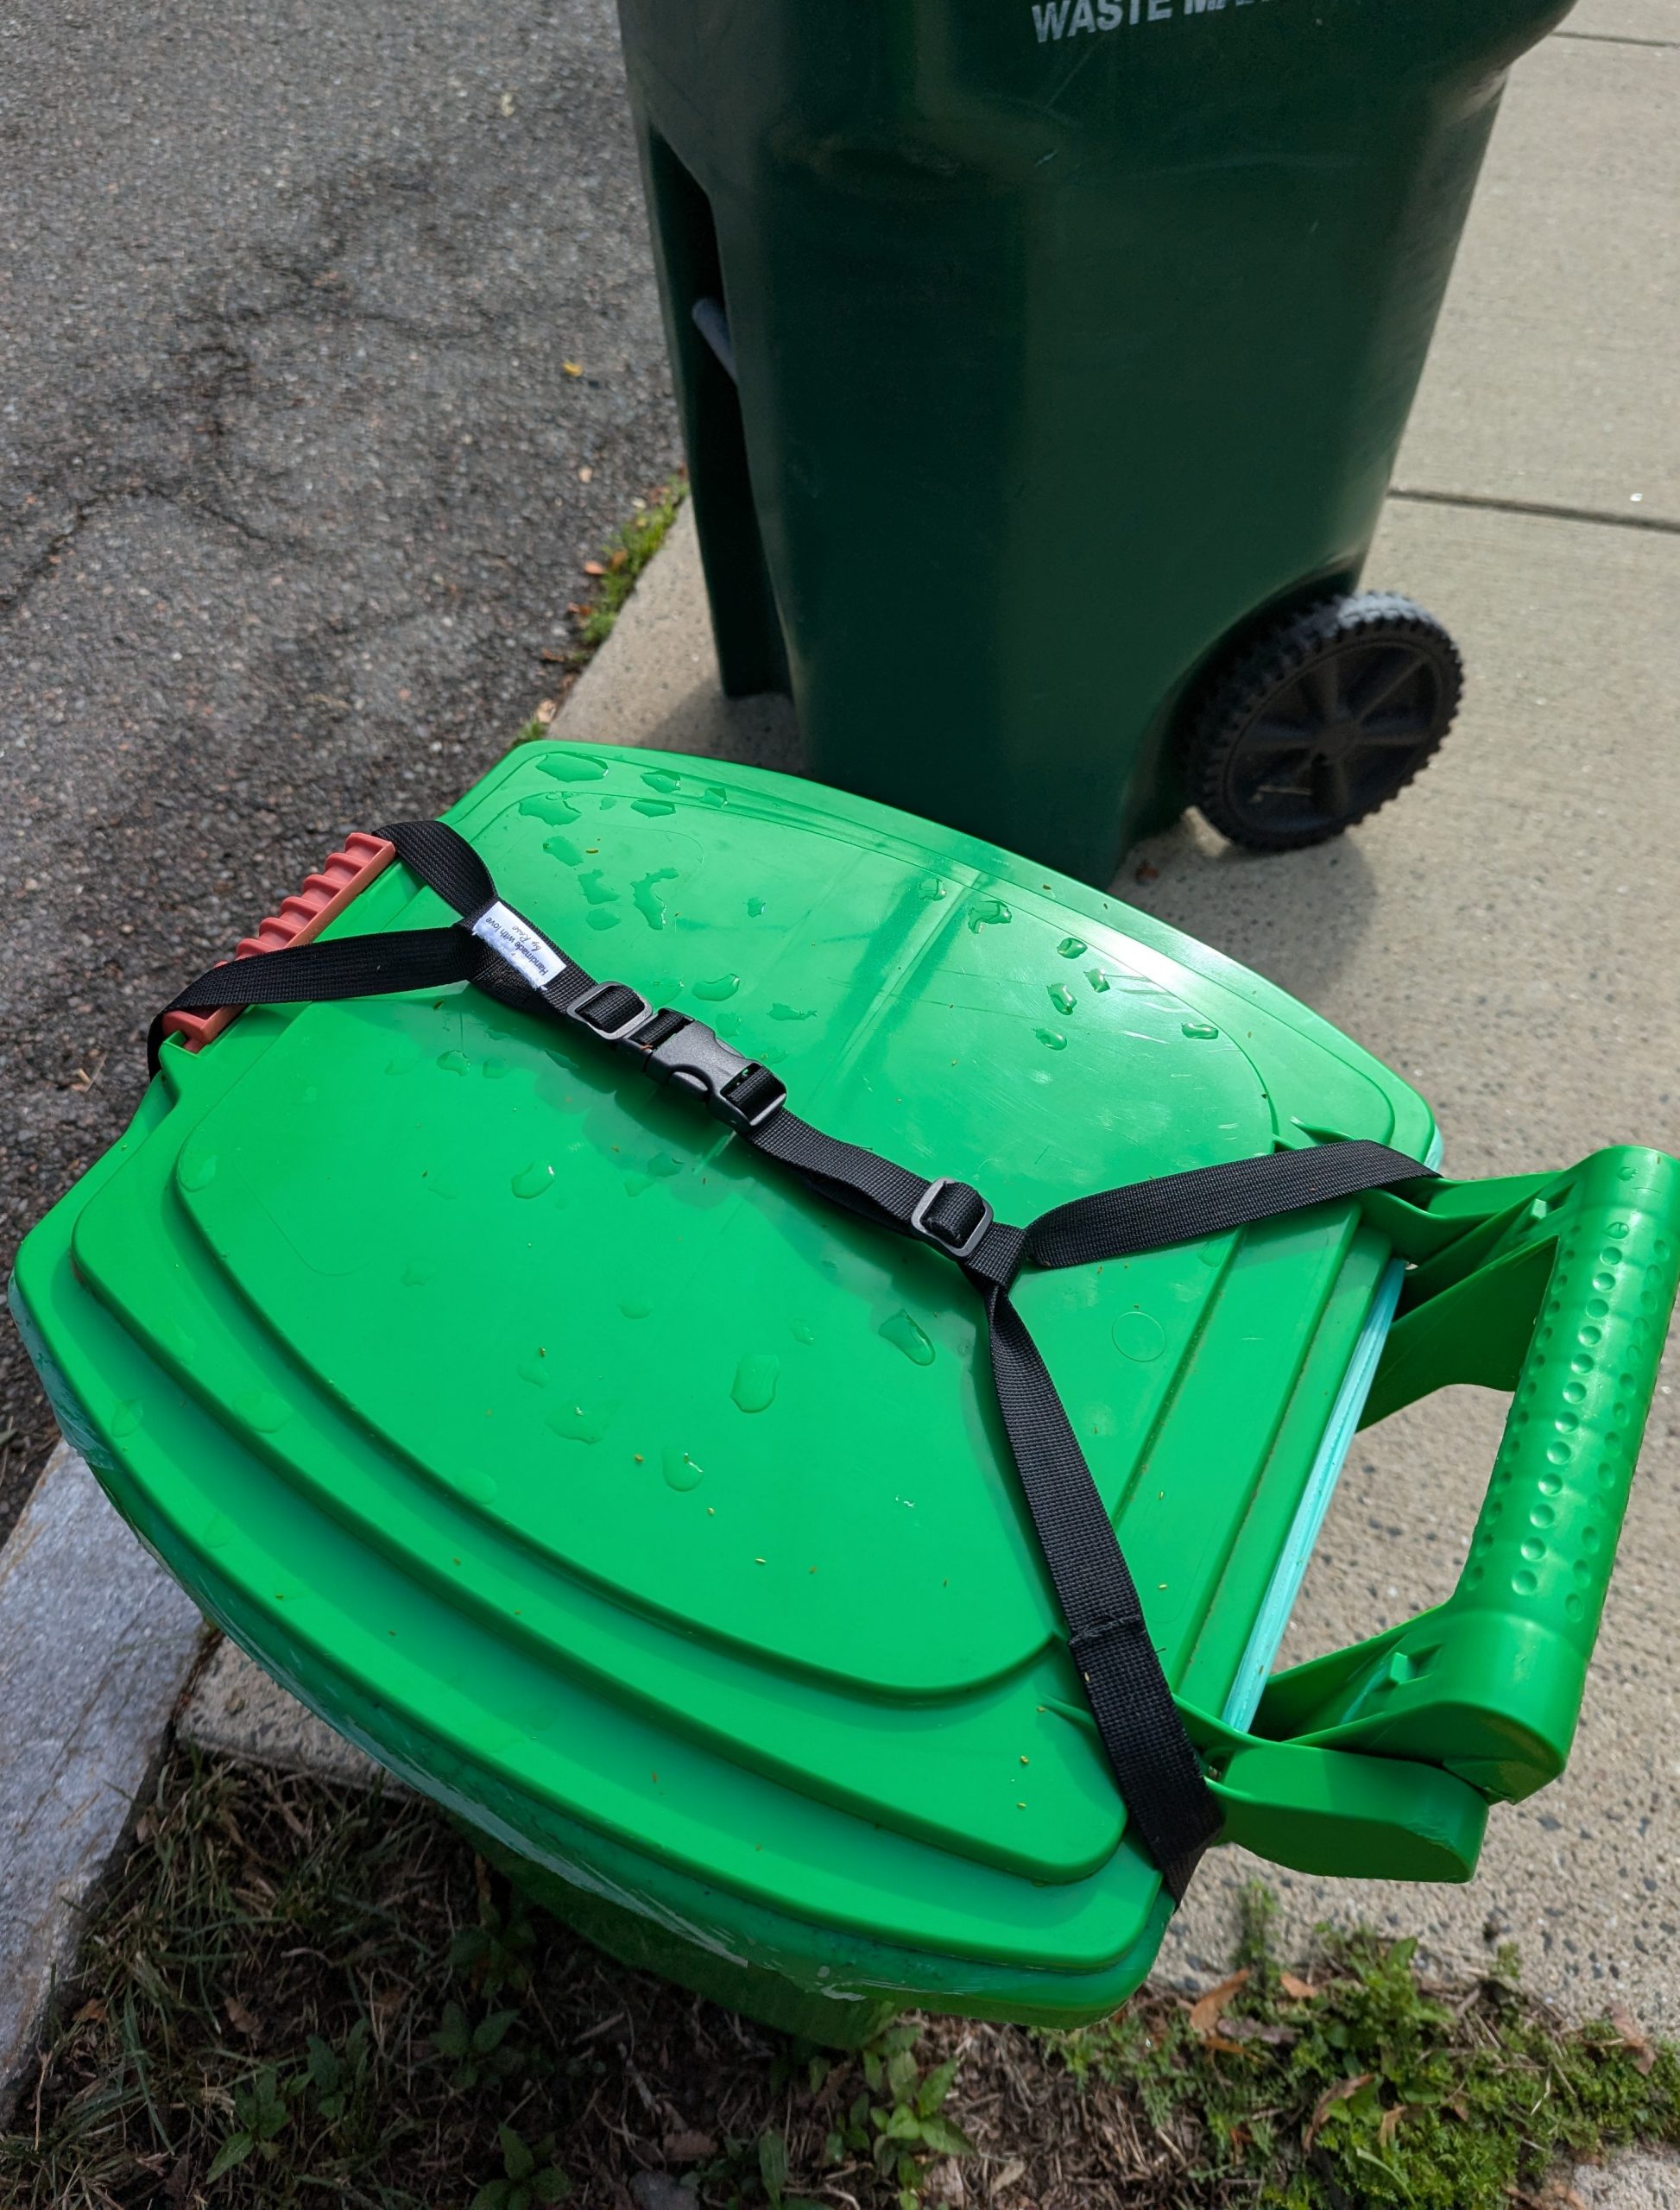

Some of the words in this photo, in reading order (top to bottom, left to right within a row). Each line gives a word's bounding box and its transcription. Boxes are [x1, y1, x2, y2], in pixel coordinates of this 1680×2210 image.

[485, 917, 502, 932] love
[500, 928, 516, 943] with
[511, 925, 532, 943] Rose
[531, 941, 541, 951] by
[515, 941, 548, 976] Handmade
